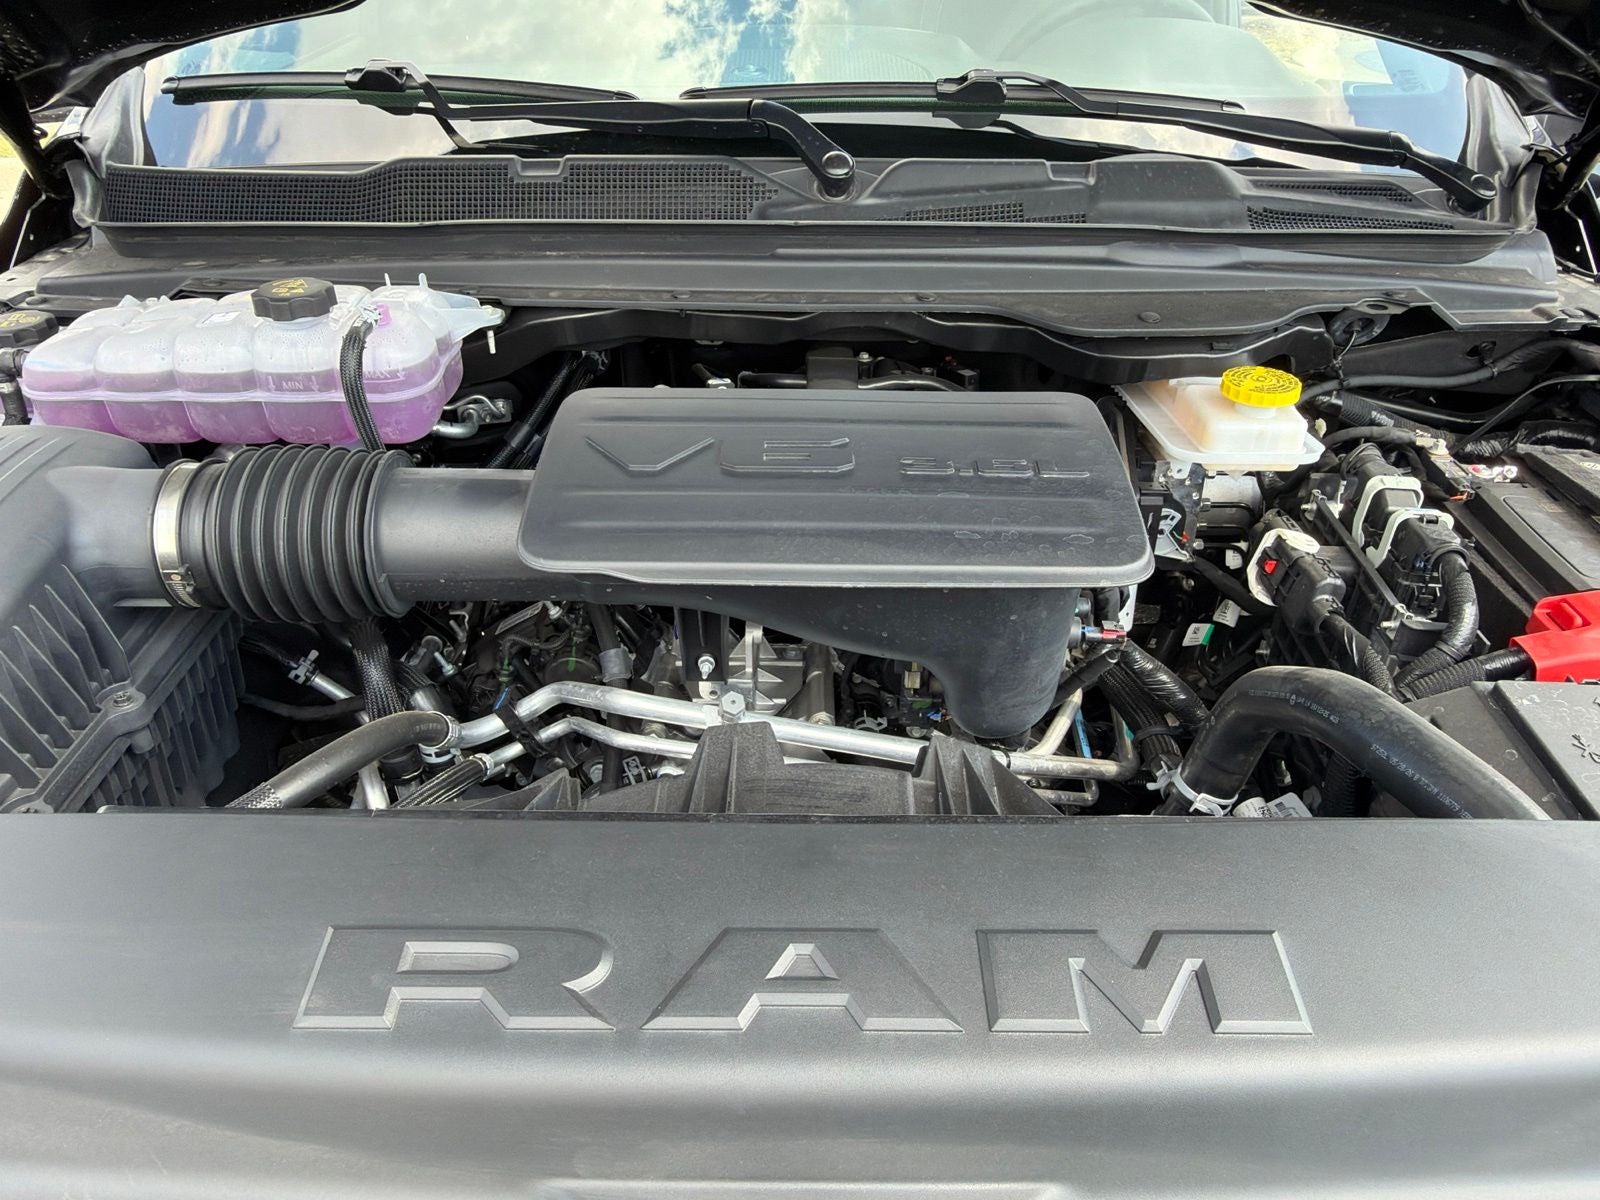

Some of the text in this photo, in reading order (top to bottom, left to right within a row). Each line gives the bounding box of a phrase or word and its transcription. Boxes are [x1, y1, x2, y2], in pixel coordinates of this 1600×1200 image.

[365, 369, 391, 379] MAX
[281, 381, 304, 391] MIN
[585, 436, 856, 473] V6
[293, 925, 1314, 1035] RAM
